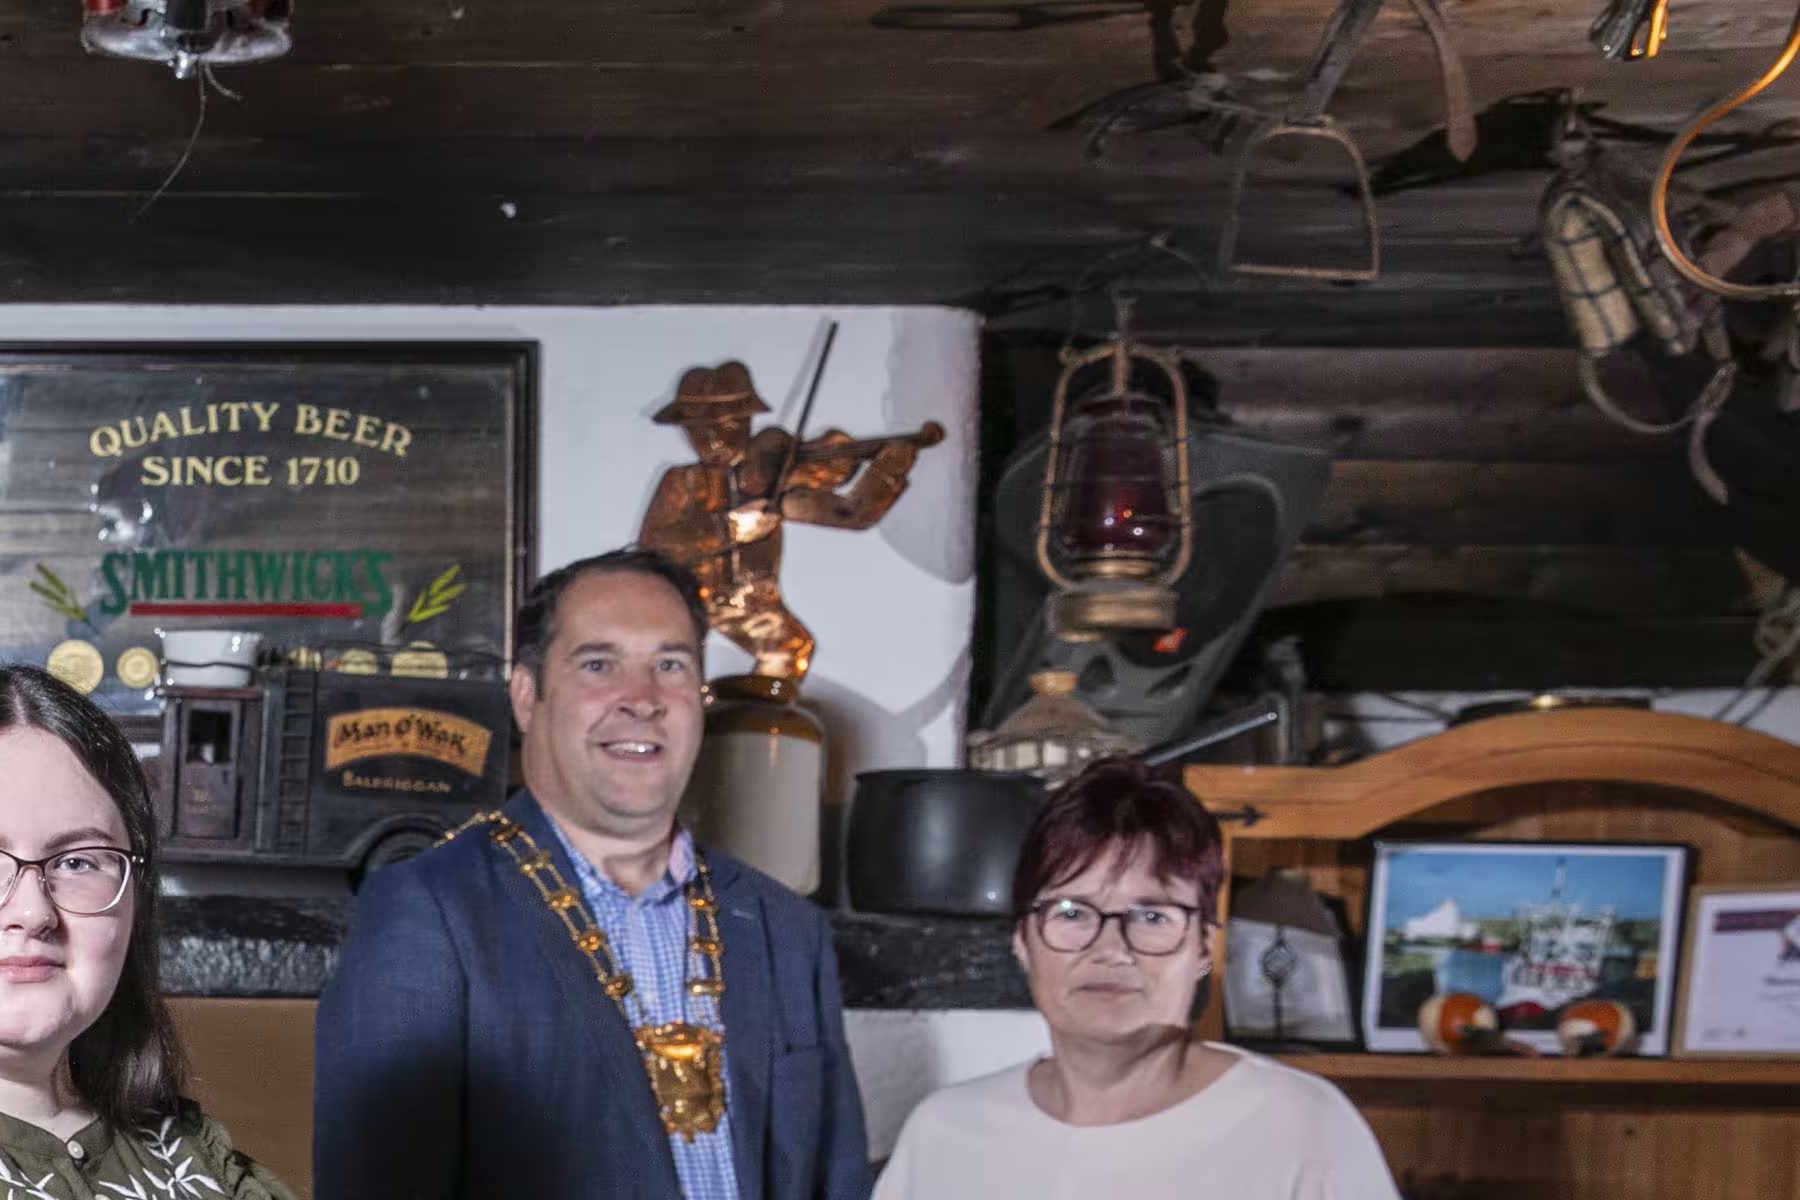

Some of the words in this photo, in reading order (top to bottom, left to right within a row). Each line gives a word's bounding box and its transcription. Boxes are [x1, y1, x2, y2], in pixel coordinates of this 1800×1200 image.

[90, 401, 280, 457] QUALITY
[295, 404, 412, 456] BEER
[140, 455, 272, 487] SINCE
[286, 456, 361, 486] 1710
